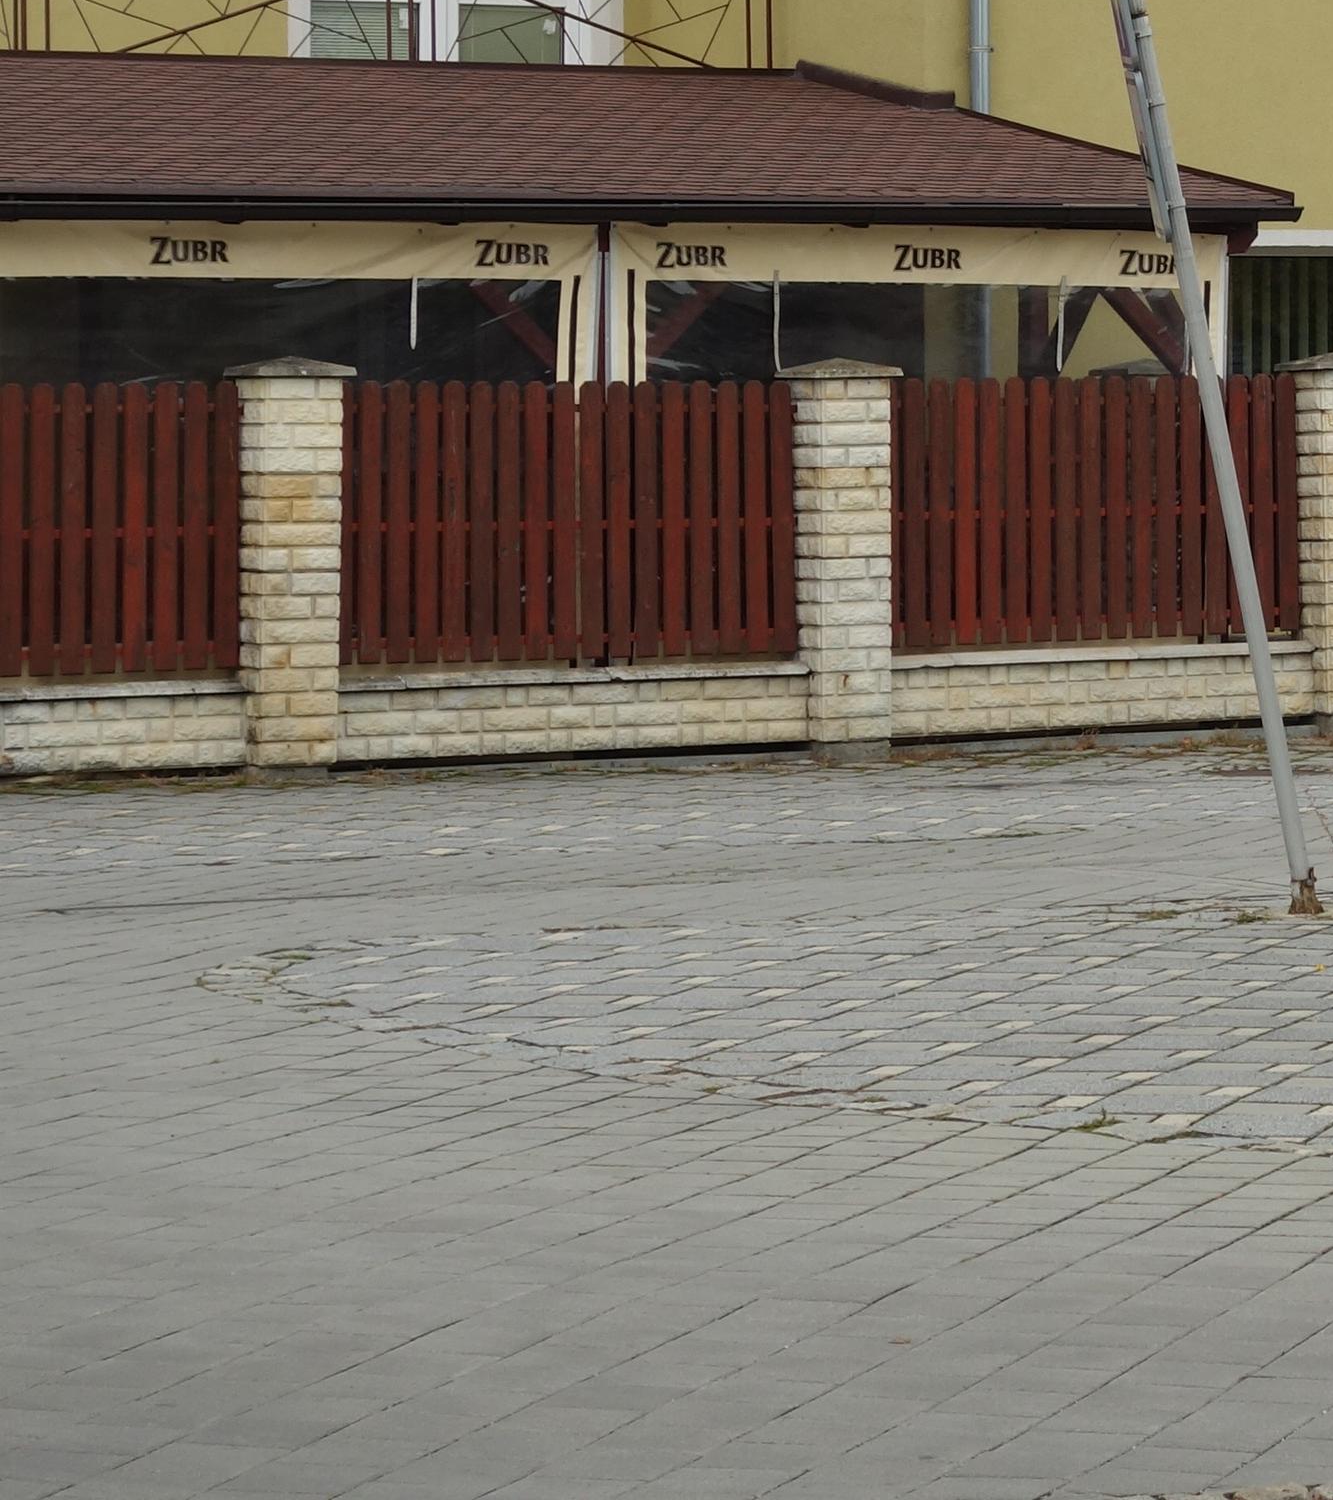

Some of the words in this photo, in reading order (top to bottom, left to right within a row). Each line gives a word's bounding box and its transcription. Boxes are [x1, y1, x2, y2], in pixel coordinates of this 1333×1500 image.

[150, 236, 228, 265] ZUBR
[475, 240, 549, 267] ZUBR
[656, 242, 727, 269] ZUBR
[894, 244, 962, 271] ZUBR
